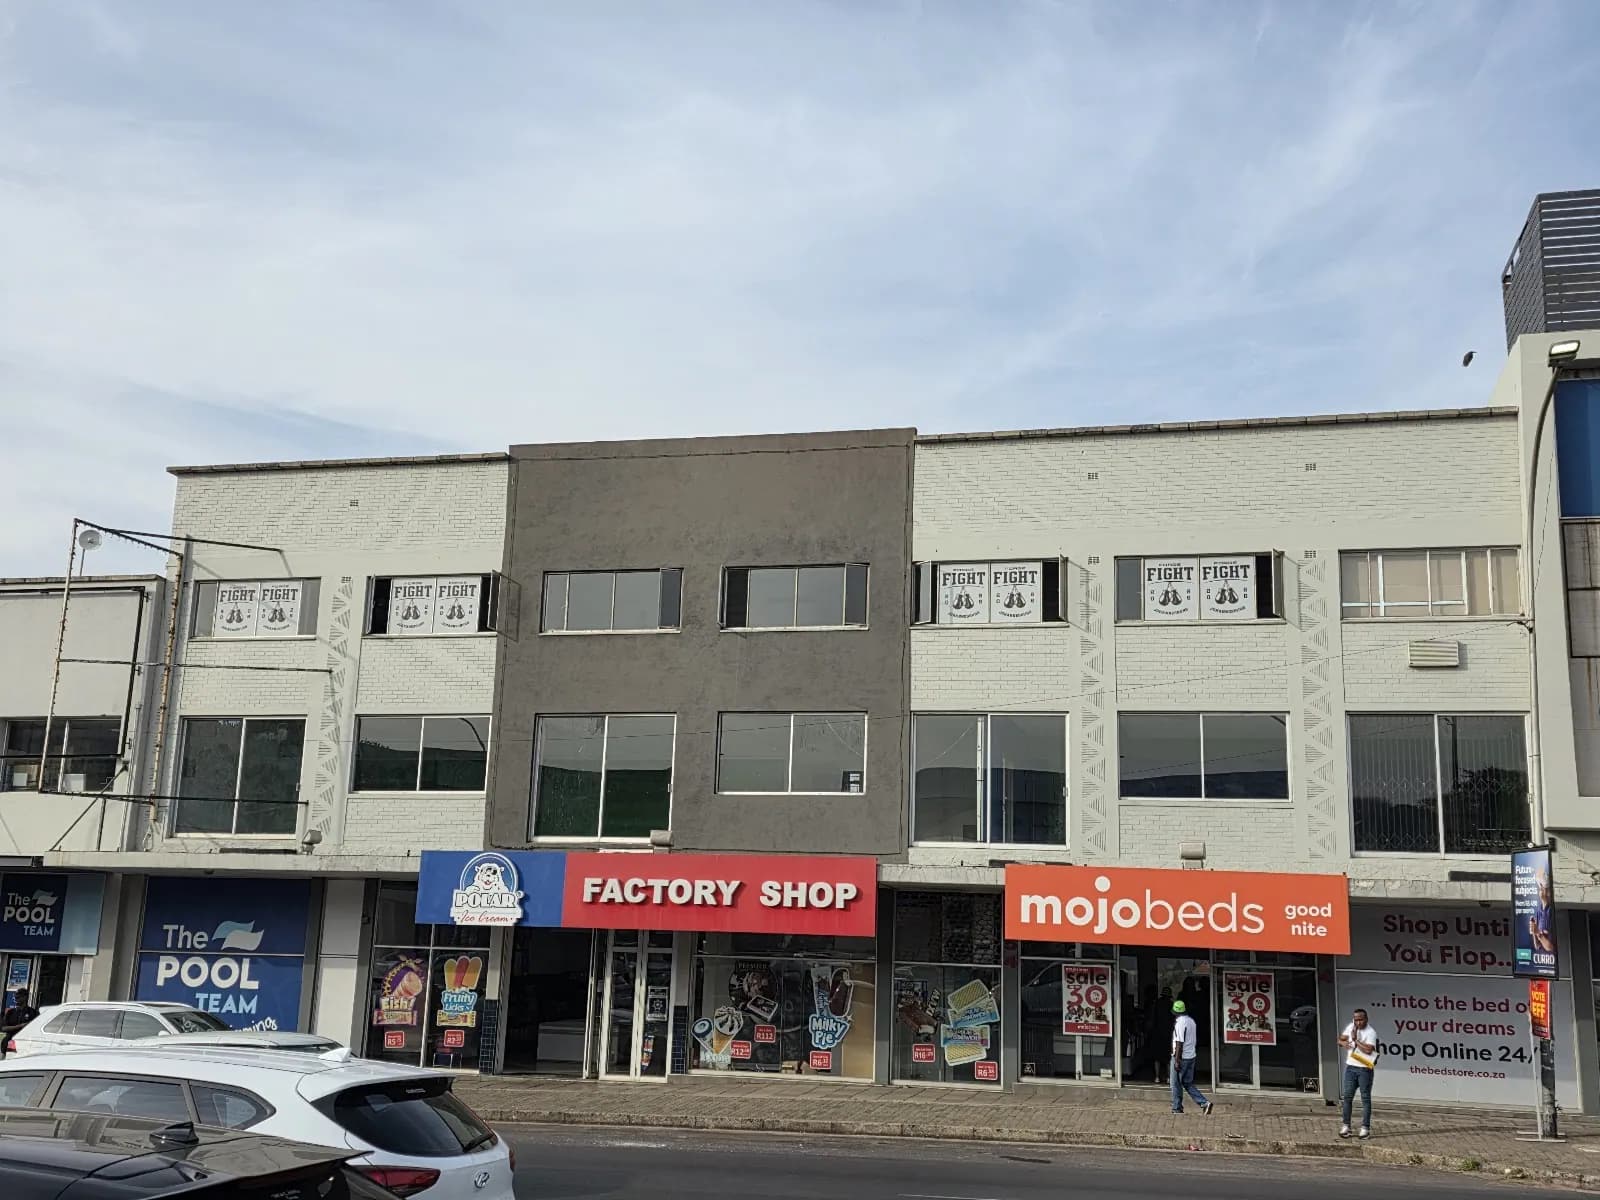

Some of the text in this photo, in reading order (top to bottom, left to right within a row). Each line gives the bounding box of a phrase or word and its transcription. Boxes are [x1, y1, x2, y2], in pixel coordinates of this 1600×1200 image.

[942, 572, 986, 586] FIGHT
[993, 571, 1038, 585] FIGHT
[1147, 567, 1194, 581] FIGHT
[1202, 565, 1250, 580] FIGHT
[220, 589, 256, 602] FIGHT
[261, 588, 299, 601] FIGHT
[394, 585, 433, 598] FIGHT
[438, 584, 477, 598] FIGHT
[8, 893, 31, 906] The
[455, 891, 517, 908] POLAR
[583, 878, 857, 909] FACTORY SHOP
[1020, 876, 1265, 935] mojobeds
[1284, 903, 1332, 920] good
[3, 906, 55, 924] POOL
[461, 909, 509, 923] Ice Cream
[24, 925, 54, 936] TEAM
[1291, 921, 1328, 937] nite
[1384, 914, 1510, 939] Shop Unti
[163, 924, 209, 950] The
[1384, 944, 1432, 963] You
[1533, 953, 1555, 965] CURRO
[156, 955, 259, 990] POOL
[1067, 970, 1107, 985] sale
[1227, 977, 1271, 993] sale
[195, 992, 258, 1014] TEAM
[381, 996, 417, 1010] Eish!
[444, 992, 475, 1005] Fruity
[1067, 985, 1108, 1008] 30
[1228, 992, 1271, 1015] 30
[1391, 993, 1430, 1009] into
[1435, 995, 1467, 1011] the
[1472, 997, 1510, 1013] bed
[1515, 1000, 1531, 1014] o
[1532, 991, 1546, 1001] VOTE
[1532, 1002, 1546, 1018] EFF
[812, 1017, 846, 1038] Milky
[1394, 1019, 1437, 1034] your
[1442, 1019, 1516, 1036] dreams
[815, 1031, 833, 1045] Pie
[1376, 1039, 1415, 1061] hop
[1422, 1041, 1492, 1061] Online
[1410, 1065, 1506, 1079] thebedstore.co.za
